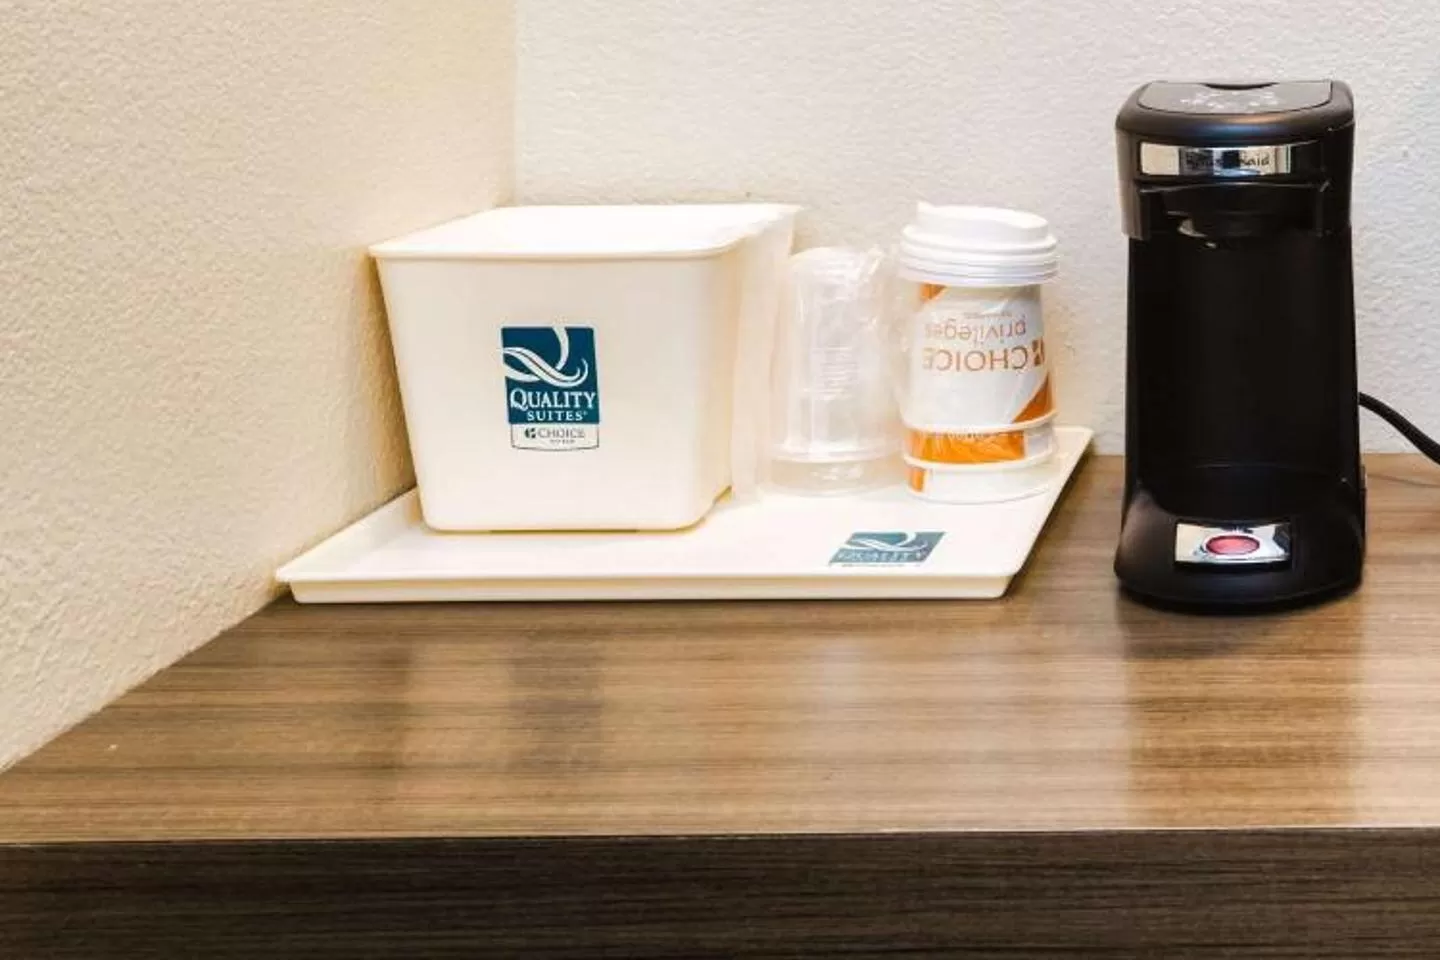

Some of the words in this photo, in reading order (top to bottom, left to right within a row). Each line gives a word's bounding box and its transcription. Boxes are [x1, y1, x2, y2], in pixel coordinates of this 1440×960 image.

[922, 346, 1029, 373] CHOICE
[510, 388, 595, 411] QUALITY
[537, 428, 584, 438] CHOICE
